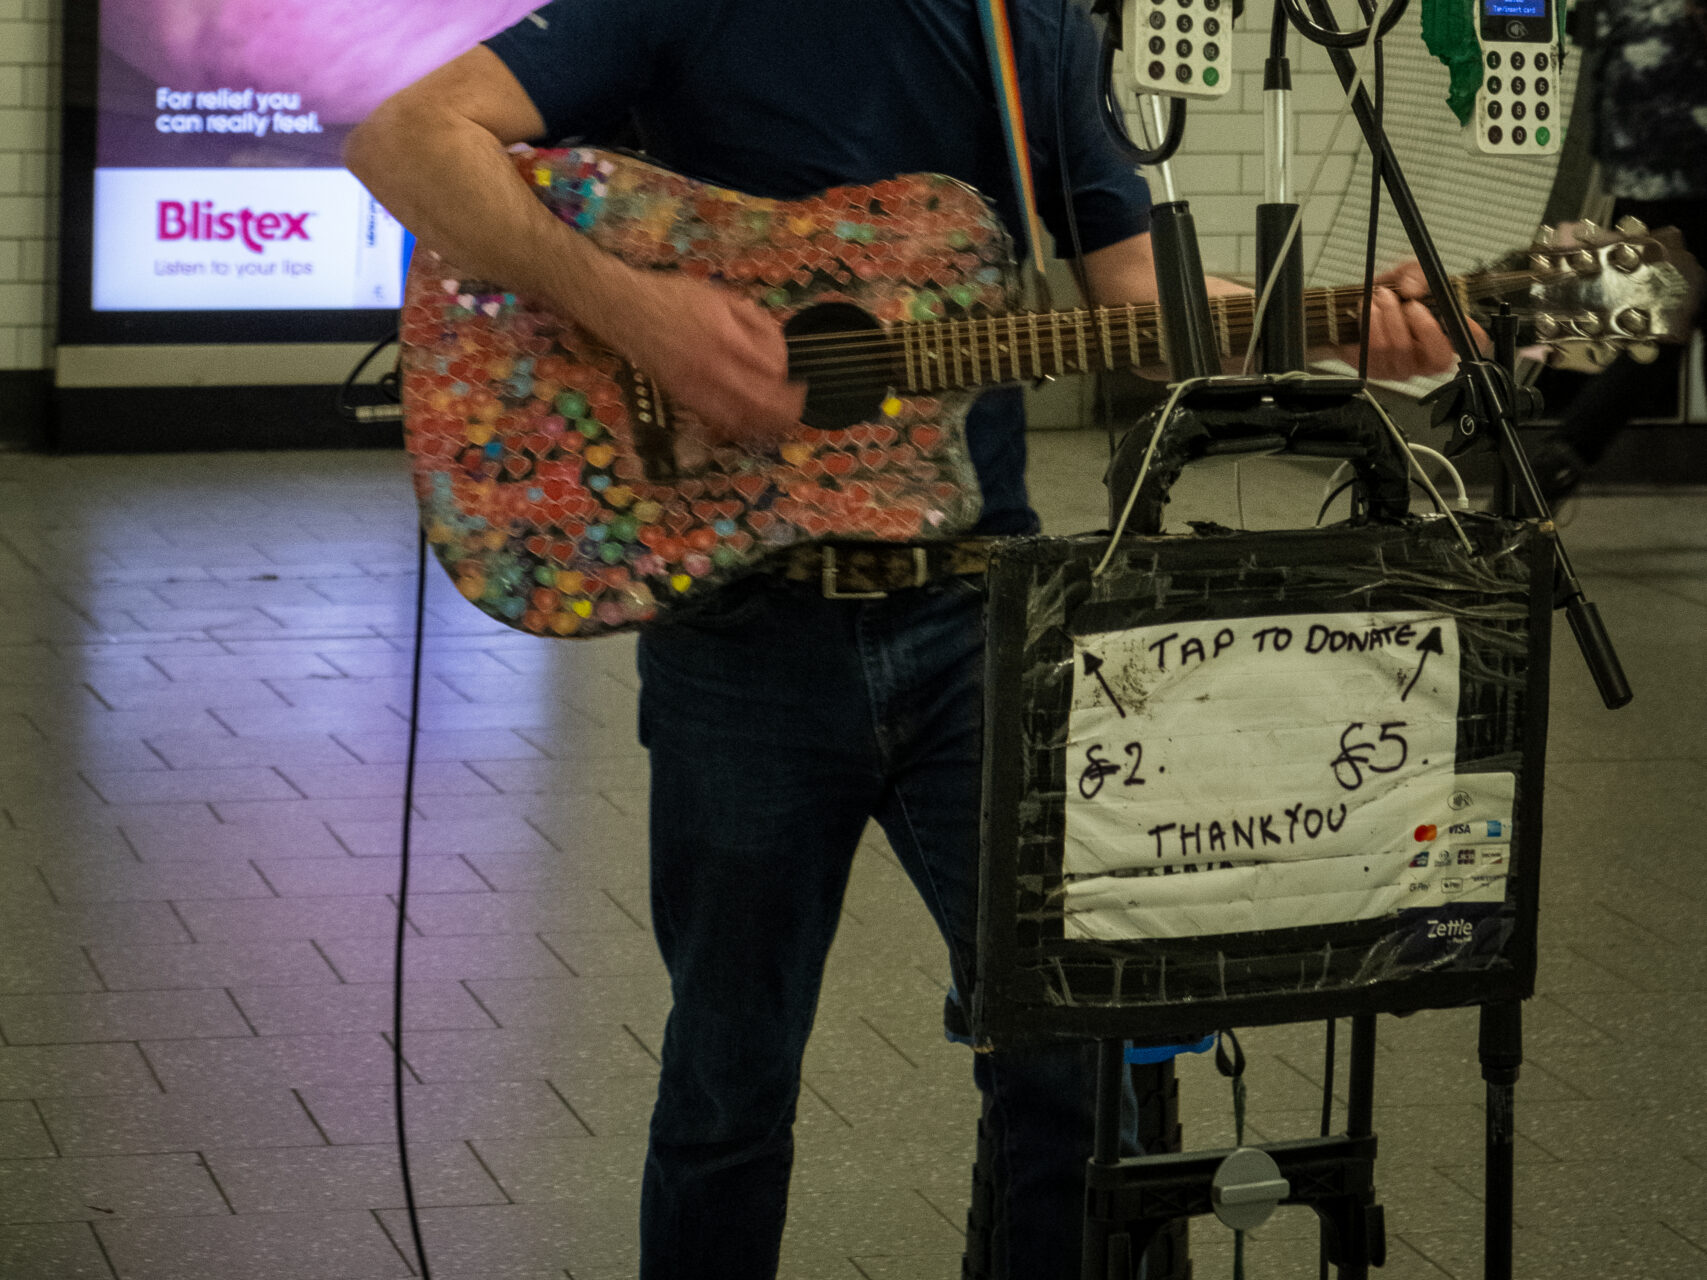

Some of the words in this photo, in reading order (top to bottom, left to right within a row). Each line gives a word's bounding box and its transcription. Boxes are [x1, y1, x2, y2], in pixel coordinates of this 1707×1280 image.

[156, 86, 193, 111] For
[195, 87, 255, 110] relief
[255, 91, 301, 114] you
[155, 114, 204, 134] can
[206, 111, 271, 138] really
[157, 200, 311, 254] Blistex
[154, 260, 204, 277] Listen
[211, 261, 230, 276] to
[235, 263, 277, 279] your
[282, 260, 314, 279] lips
[1149, 628, 1235, 671] TAP
[1252, 627, 1293, 653] TO
[1305, 624, 1417, 654] DONATE
[1448, 823, 1471, 835] VISA
[1427, 918, 1473, 939] Zettle
